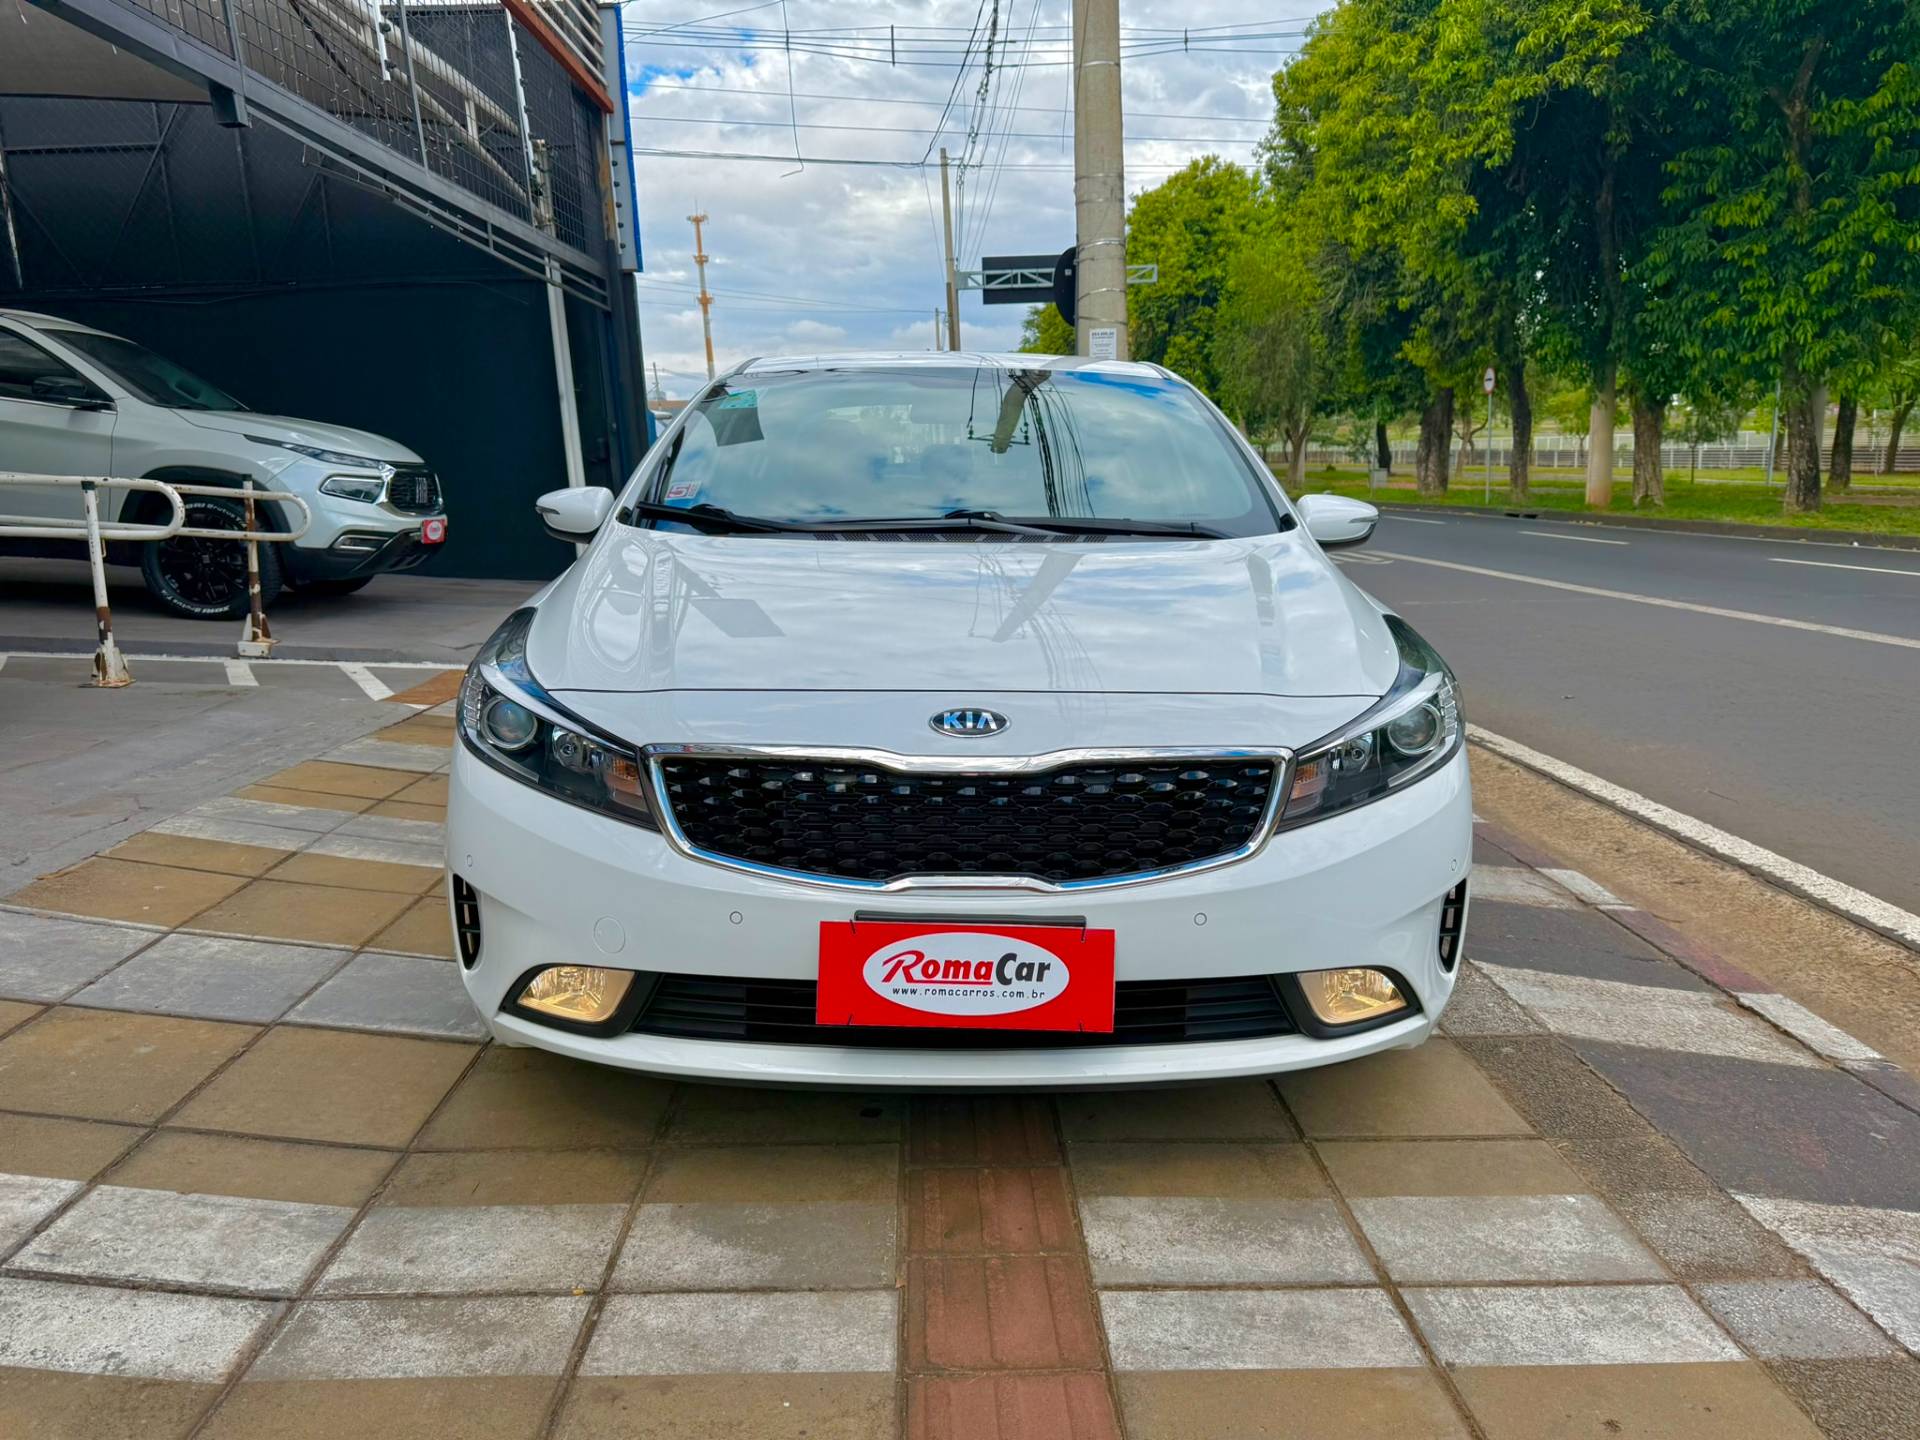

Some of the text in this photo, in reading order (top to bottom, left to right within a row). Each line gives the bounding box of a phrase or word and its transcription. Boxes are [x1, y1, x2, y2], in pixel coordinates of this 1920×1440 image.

[943, 711, 998, 730] KIA
[882, 950, 1051, 986] RomaCar
[892, 987, 1046, 999] www.romacarros.com.br
